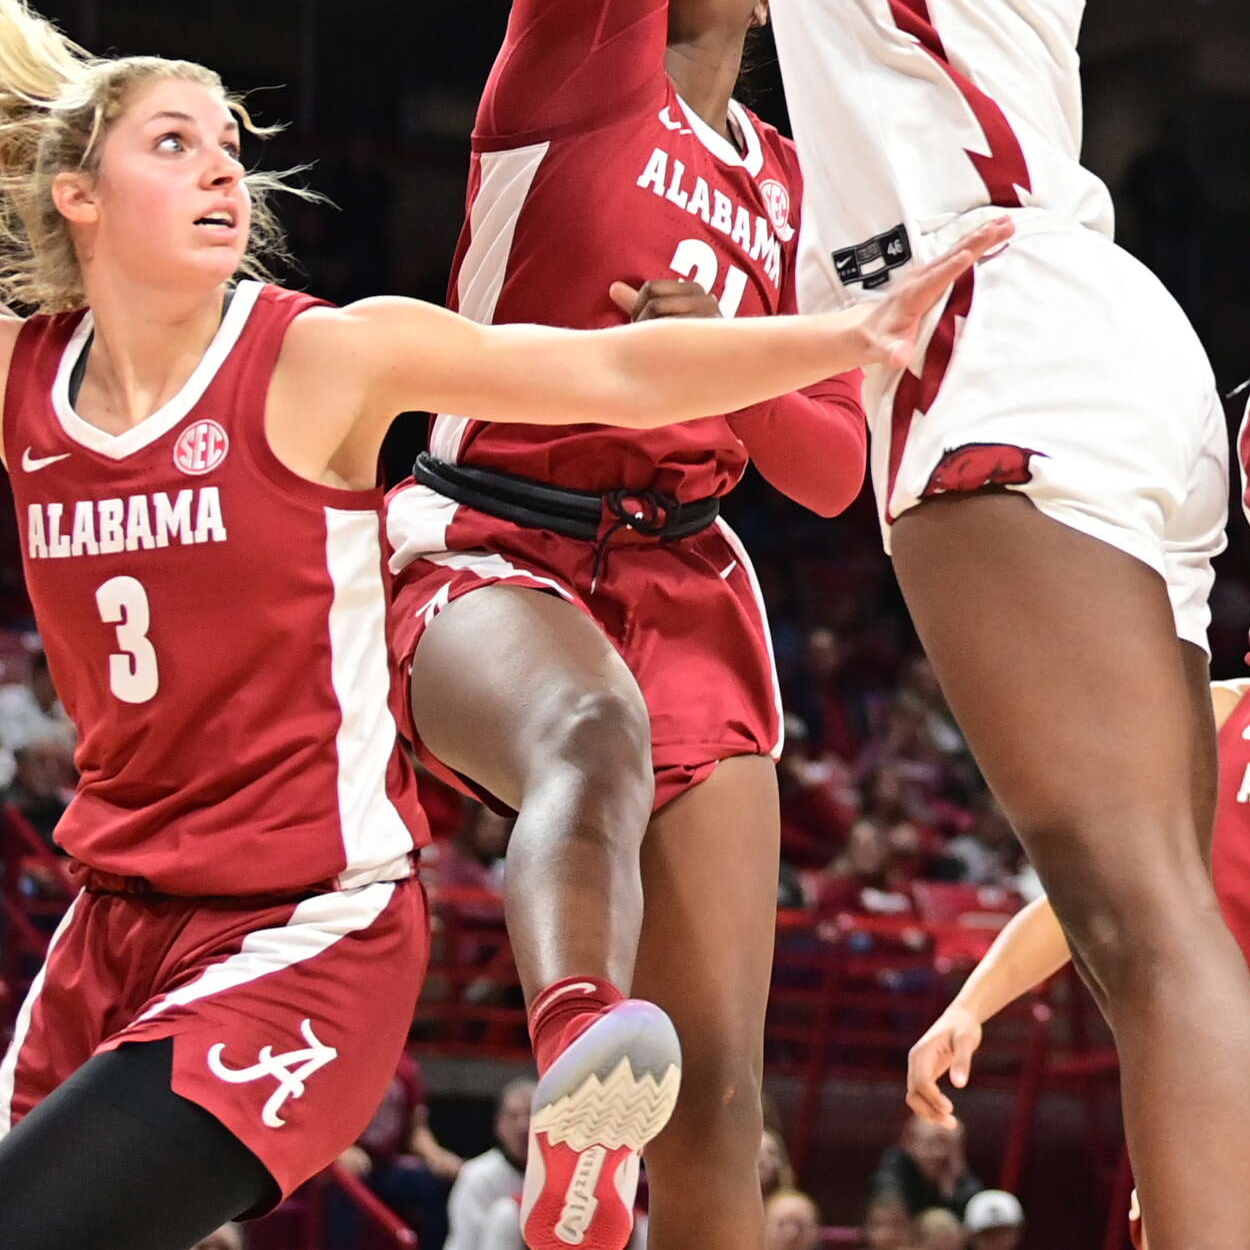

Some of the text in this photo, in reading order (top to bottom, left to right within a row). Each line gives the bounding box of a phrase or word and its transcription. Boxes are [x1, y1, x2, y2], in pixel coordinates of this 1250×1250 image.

[177, 422, 226, 470] SEC
[27, 486, 228, 559] ALABAMA
[95, 575, 160, 704] 3
